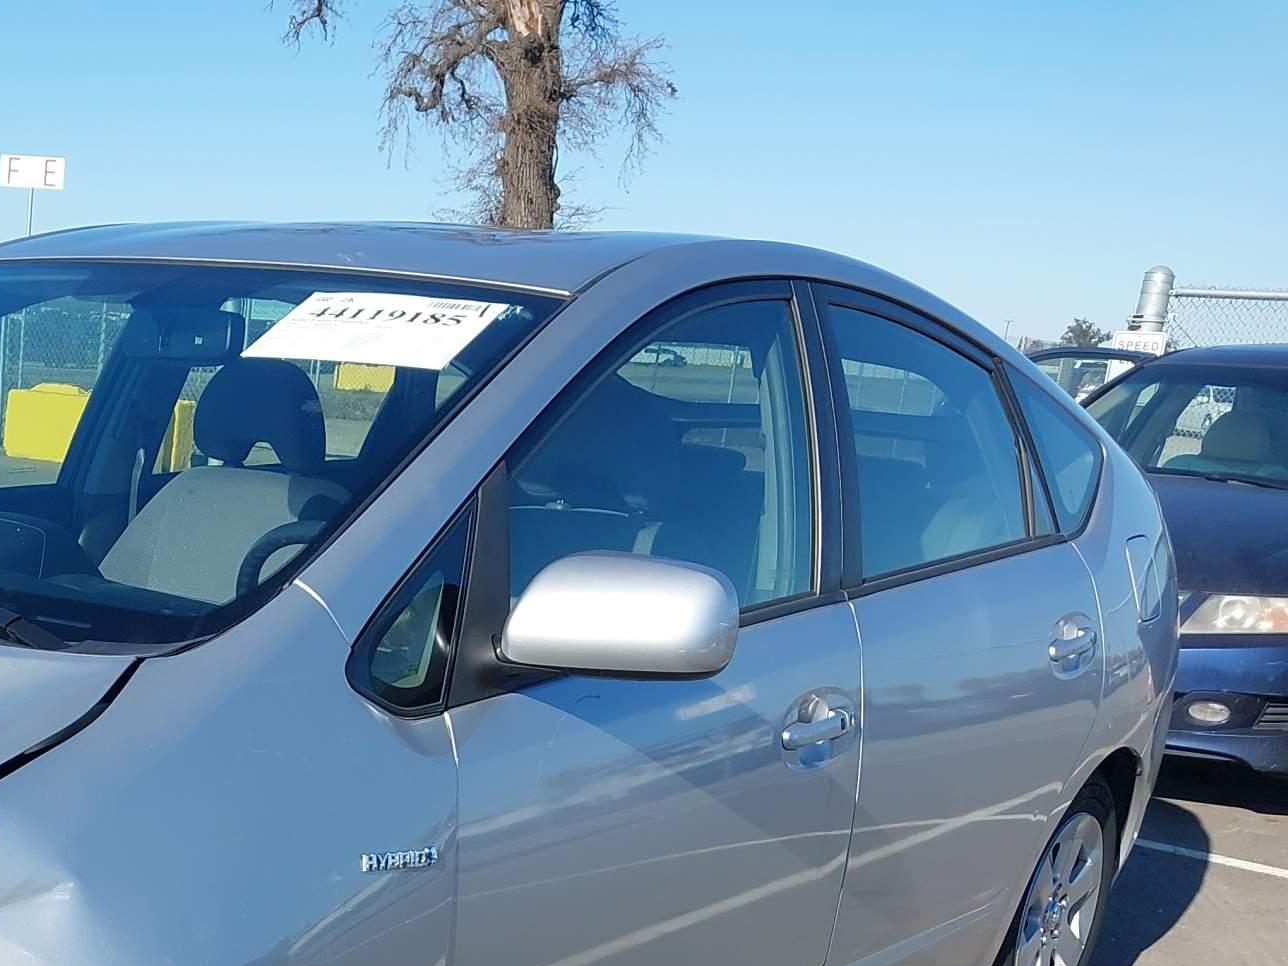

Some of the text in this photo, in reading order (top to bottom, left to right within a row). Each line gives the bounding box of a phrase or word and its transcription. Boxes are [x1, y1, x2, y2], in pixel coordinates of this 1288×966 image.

[309, 306, 468, 326] 44119185
[1118, 341, 1159, 351] SPEED
[360, 850, 427, 872] HYBRID
